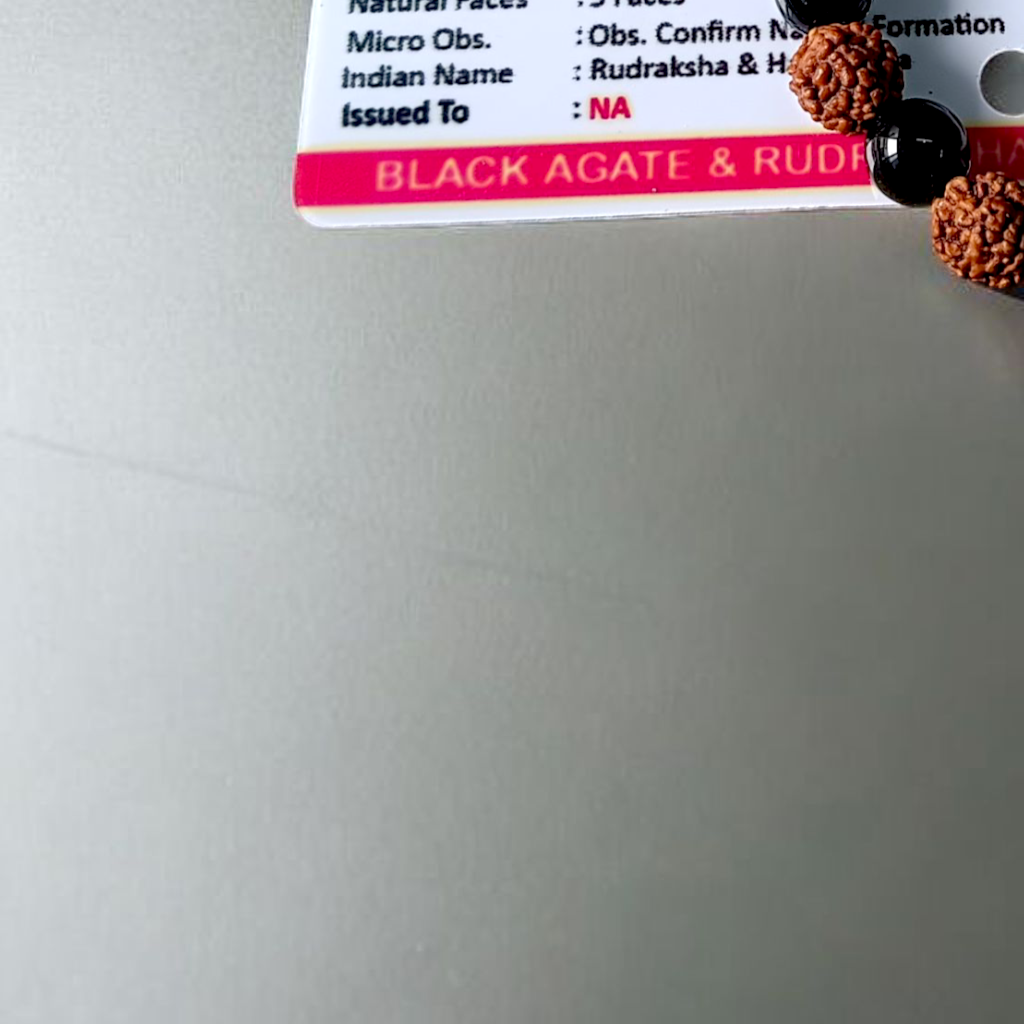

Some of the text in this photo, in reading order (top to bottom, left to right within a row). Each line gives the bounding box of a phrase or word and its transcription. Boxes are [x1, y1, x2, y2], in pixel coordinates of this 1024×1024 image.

[346, 29, 425, 53] Micro
[432, 27, 492, 51] Obs.
[588, 23, 647, 46] Obs.
[656, 20, 761, 44] Confirm
[873, 13, 1005, 37] Formation
[341, 65, 425, 89] Indian
[433, 63, 514, 86] Name
[590, 55, 729, 81] Rudraksha
[737, 53, 759, 75] &
[341, 100, 430, 128] Issued
[438, 98, 470, 123] To
[589, 96, 631, 119] NA
[375, 155, 529, 192] BLACK
[544, 148, 690, 185] AGATE
[709, 146, 737, 177] &
